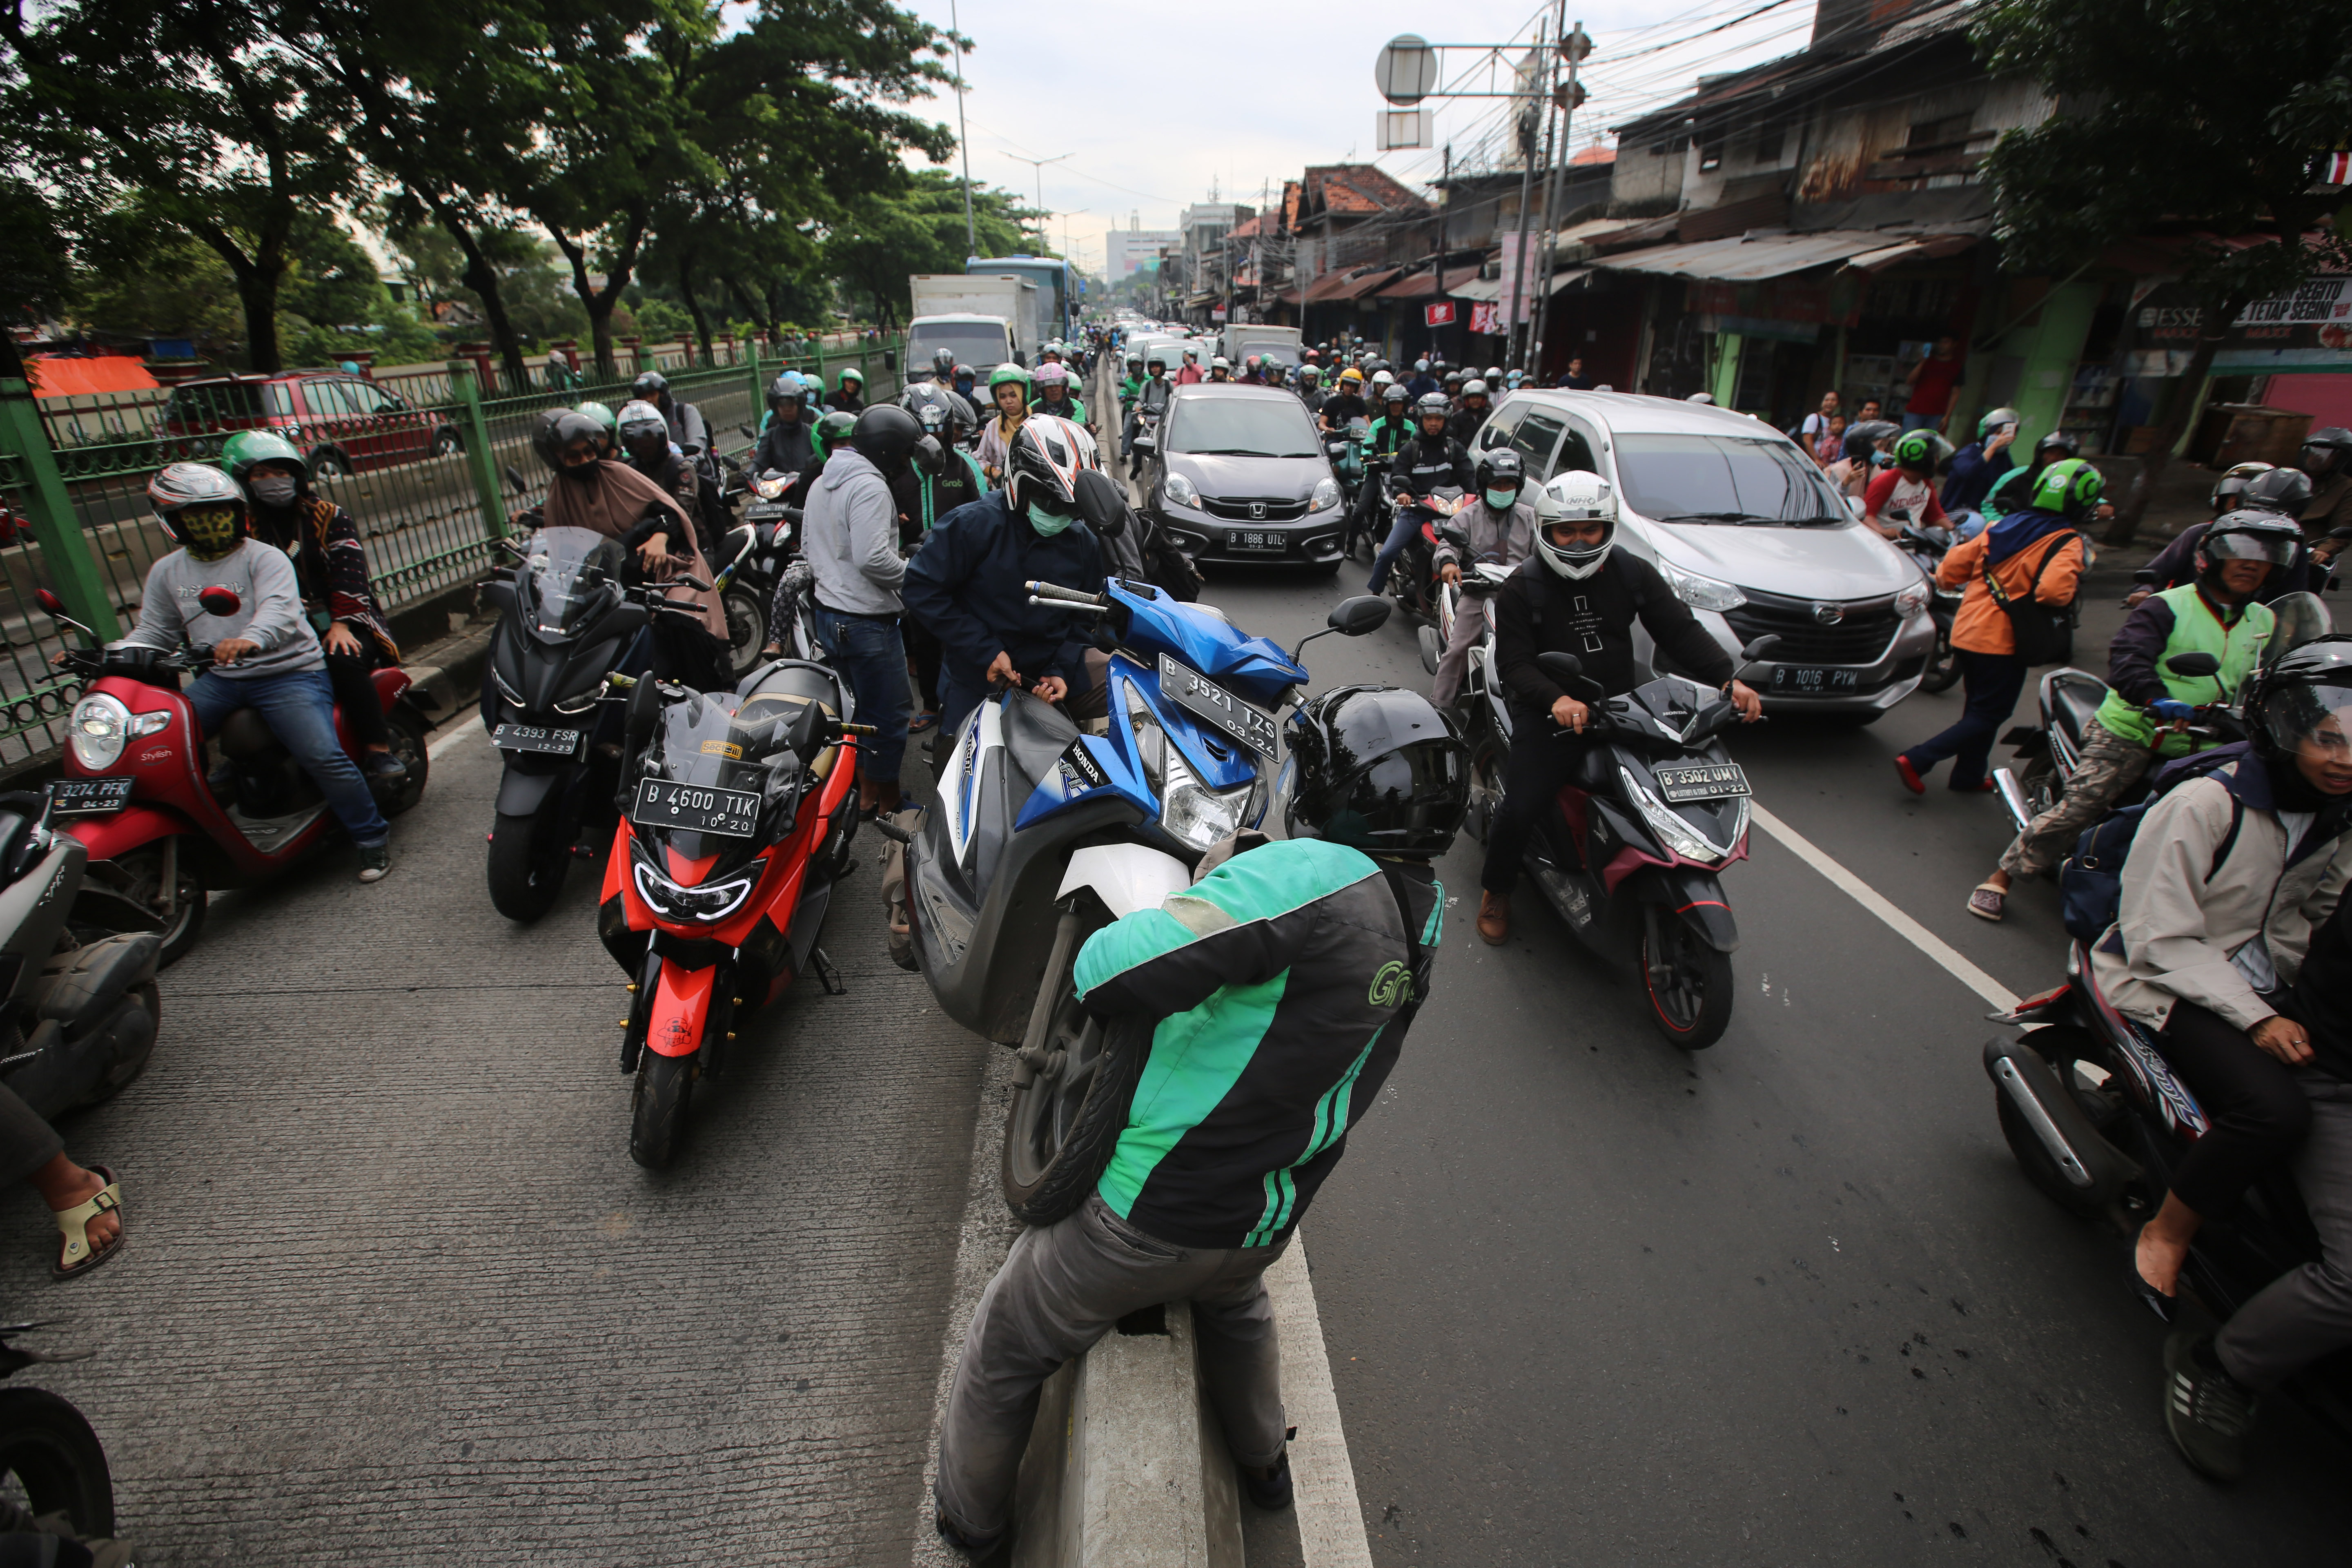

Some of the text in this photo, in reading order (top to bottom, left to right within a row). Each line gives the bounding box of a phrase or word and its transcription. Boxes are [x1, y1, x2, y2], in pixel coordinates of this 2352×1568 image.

[2296, 280, 2346, 301] SEGITU
[2157, 307, 2204, 327] ESSE
[2249, 300, 2291, 321] TETAP
[2289, 300, 2335, 321] SEGINI
[2245, 327, 2293, 339] MAXX
[942, 479, 963, 487] Grab
[1231, 532, 1283, 545] B 1886 UIL
[1776, 669, 1858, 685] B 1016 PYM
[1165, 658, 1275, 738] B 3521 TZS
[495, 725, 577, 742] B 4393 FSR
[140, 750, 172, 761] Stylish
[1072, 744, 1099, 783] HONDA
[1662, 767, 1739, 786] B 3502 UMY
[62, 784, 97, 797] 3274
[98, 782, 129, 795] PFK
[647, 784, 755, 817] B 4600 TIK
